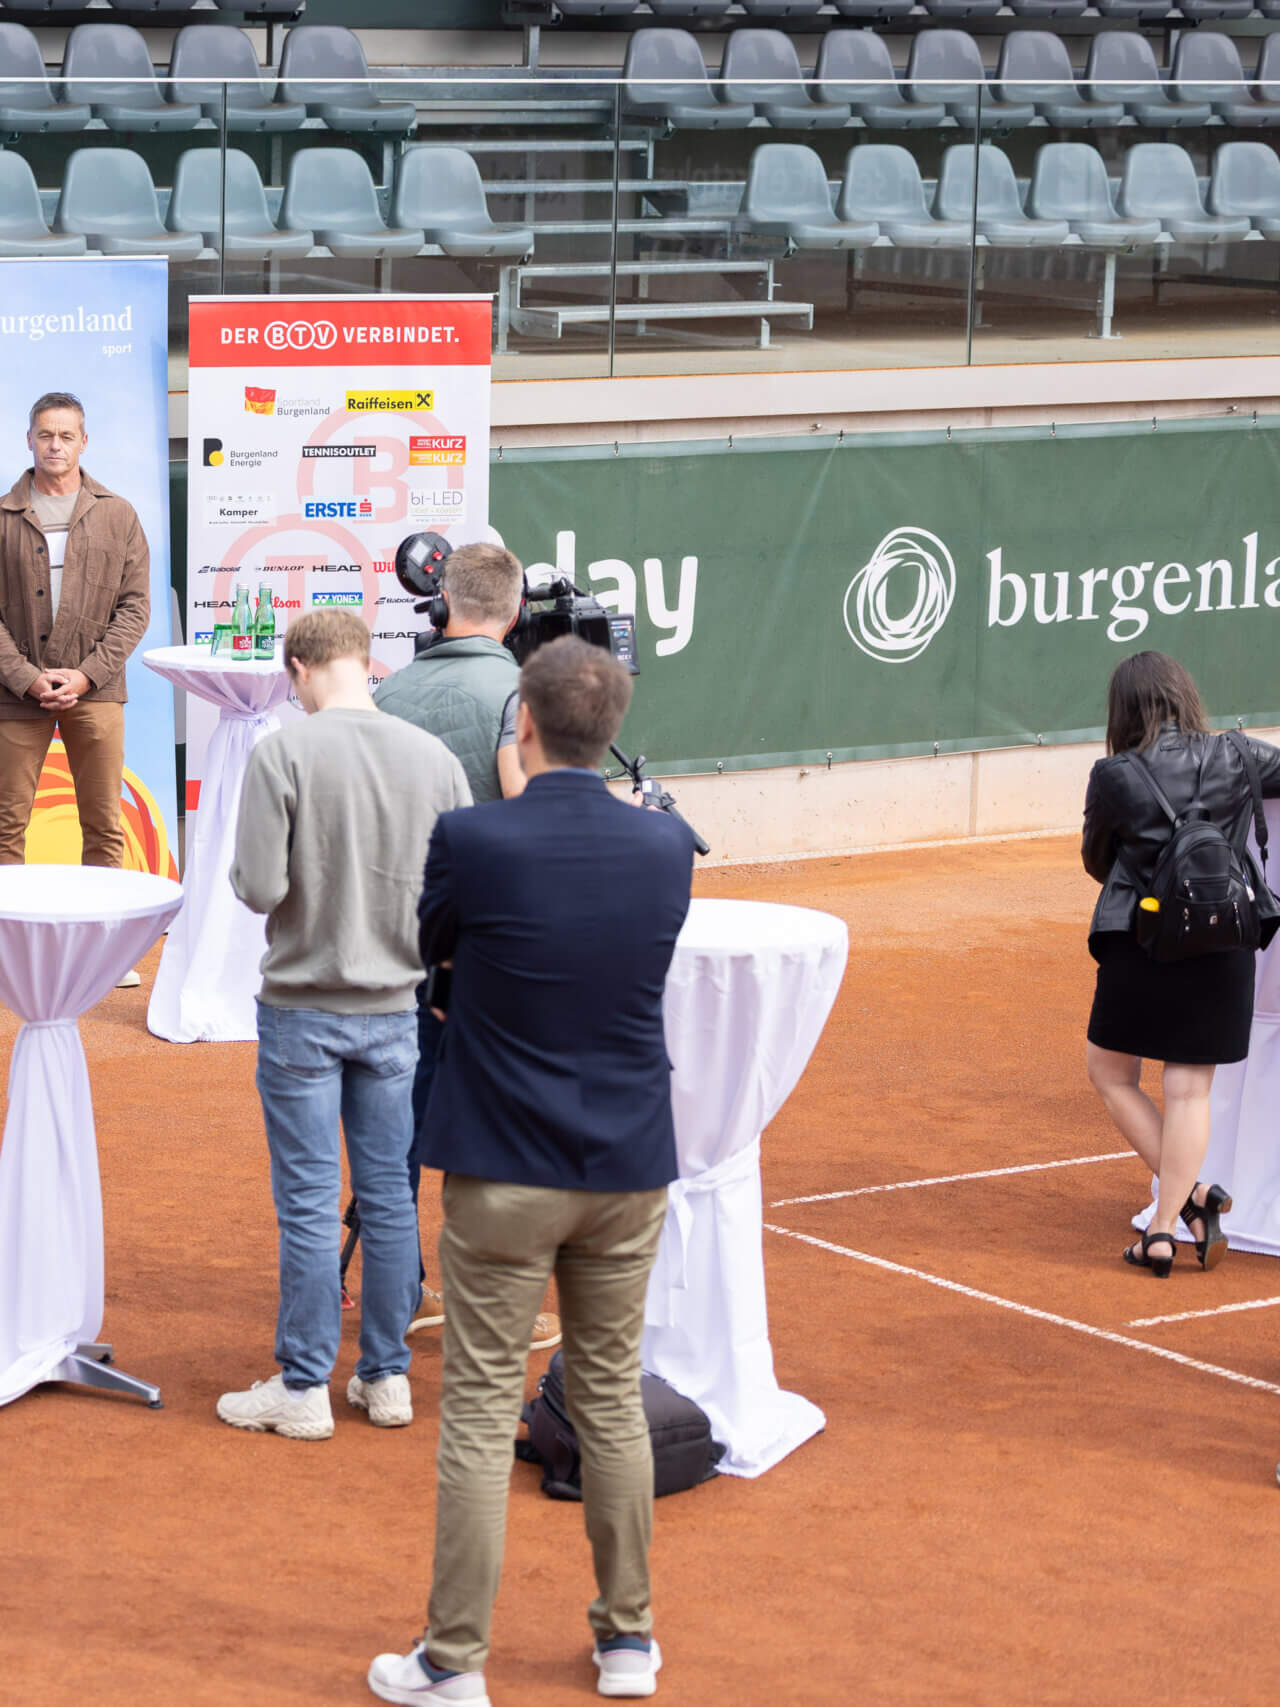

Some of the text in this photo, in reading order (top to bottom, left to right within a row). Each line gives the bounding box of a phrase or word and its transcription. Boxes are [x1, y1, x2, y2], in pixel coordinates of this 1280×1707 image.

[221, 324, 460, 347] DER BTV VERBINDET.
[102, 344, 132, 358] sport
[347, 397, 413, 410] Raiffeisen
[277, 406, 330, 418] Burgenland
[230, 450, 278, 460] Burgenland
[303, 447, 375, 457] TENNISOUTLET
[230, 459, 262, 468] Energie
[219, 508, 258, 518] Kamper
[305, 502, 356, 518] ERSTE
[373, 561, 396, 573] Wil
[985, 530, 1280, 642] burgenla
[332, 594, 361, 604] YONEX
[505, 529, 698, 657] day
[371, 631, 419, 639] HEAD
